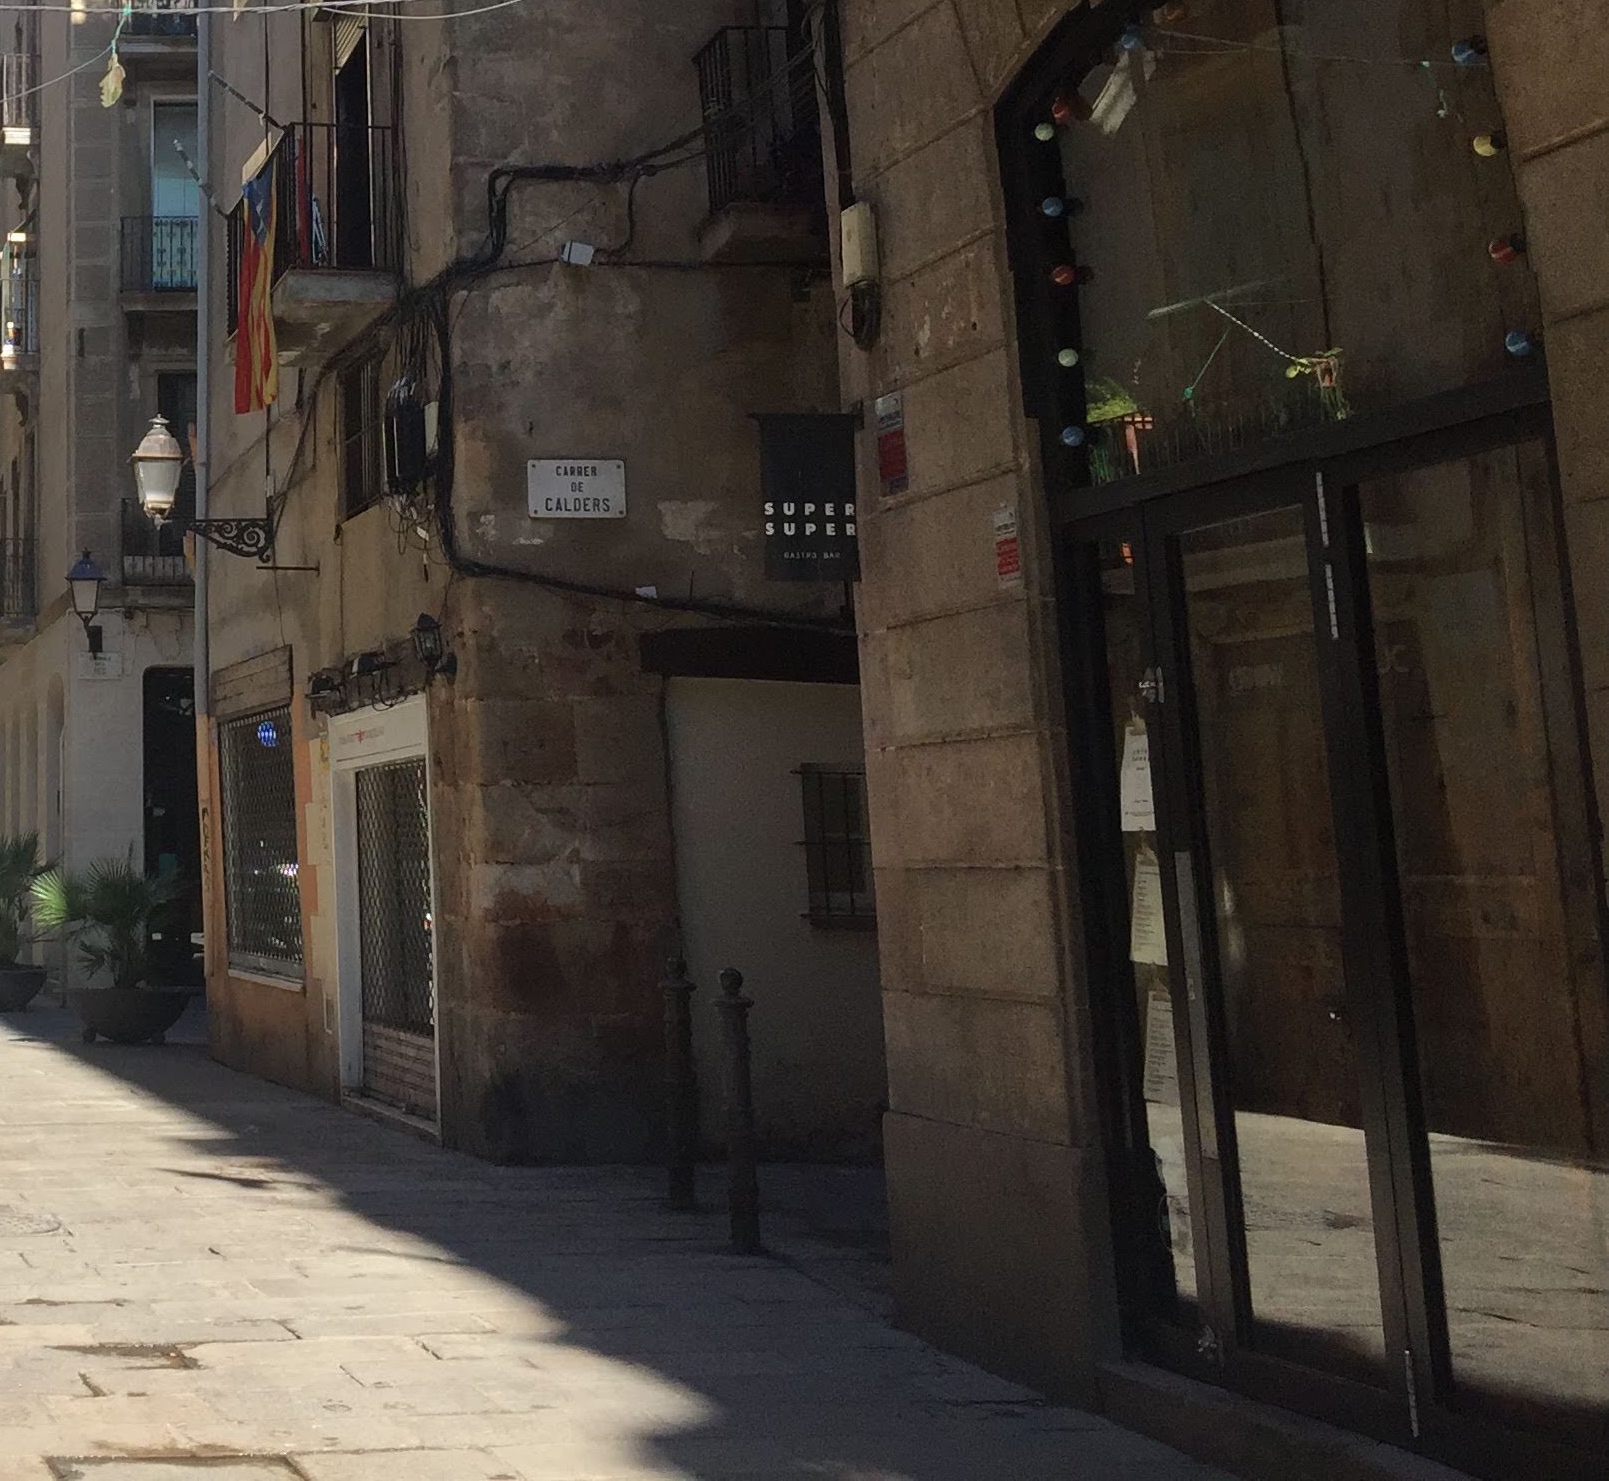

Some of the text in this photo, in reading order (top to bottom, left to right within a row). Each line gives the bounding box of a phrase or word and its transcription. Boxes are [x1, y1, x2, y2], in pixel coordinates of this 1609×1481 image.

[555, 466, 598, 477] CARRER
[570, 481, 584, 493] DE
[544, 497, 611, 513] CALDERS
[764, 502, 856, 516] SUPER
[765, 522, 857, 536] SUPER
[783, 551, 842, 560] GASTRO BAR
